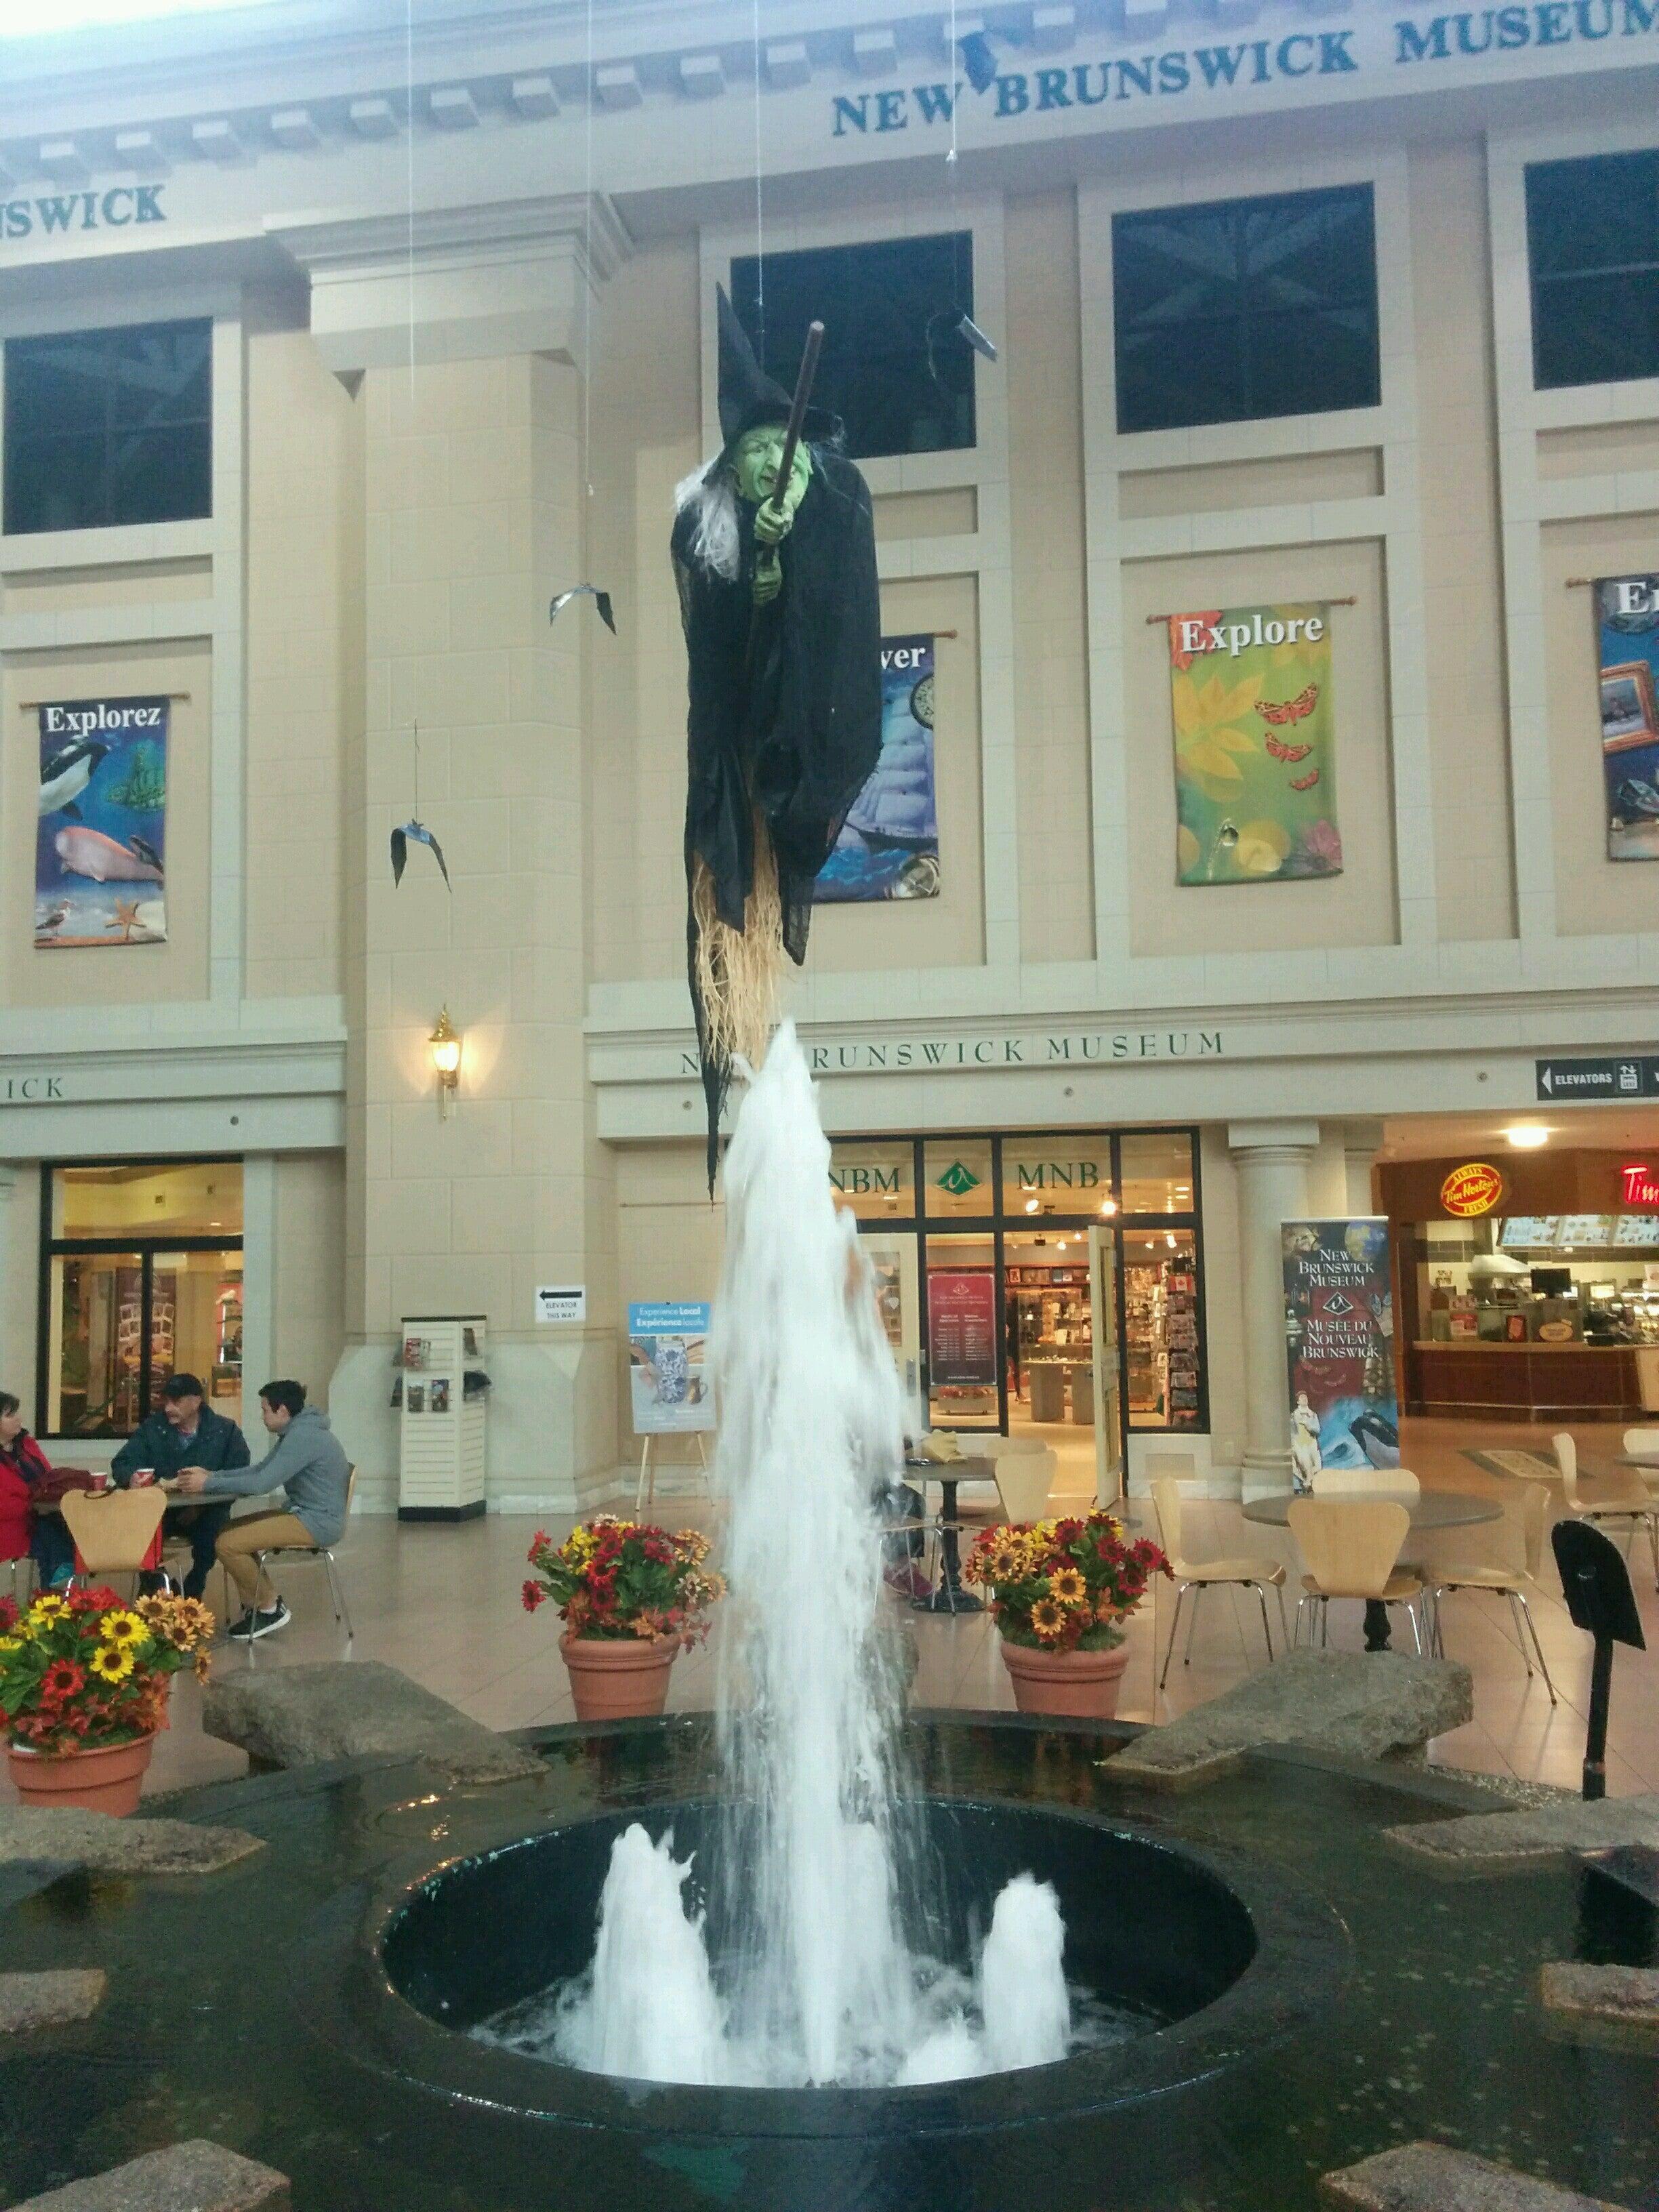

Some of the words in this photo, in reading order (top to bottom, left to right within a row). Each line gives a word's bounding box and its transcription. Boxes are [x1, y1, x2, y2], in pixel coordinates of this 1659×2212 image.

[832, 81, 964, 136] NEW
[994, 30, 1358, 118] BRUNSWICK
[0, 184, 167, 238] SWICK
[1179, 614, 1324, 657] Explore
[45, 704, 161, 736] Explorez
[812, 1040, 1023, 1069] RUNSWICK
[1047, 1032, 1223, 1061] MUSEUM
[1555, 1073, 1613, 1085] ELEVATORS
[828, 1167, 901, 1193] NBM
[1017, 1161, 1099, 1189] MNB
[1453, 1168, 1483, 1182] ALWAYS
[1443, 1189, 1462, 1203] Tim
[1463, 1178, 1498, 1197] Hortons
[1464, 1199, 1488, 1213] FRESH
[1298, 1261, 1374, 1274] BRUNSWICK
[1309, 1274, 1365, 1286] MUSEUM
[679, 1307, 701, 1315] Local
[1355, 1320, 1372, 1332] DU
[1309, 1332, 1371, 1345] NOUVEAU
[1303, 1345, 1378, 1359] BRUNSWICK
